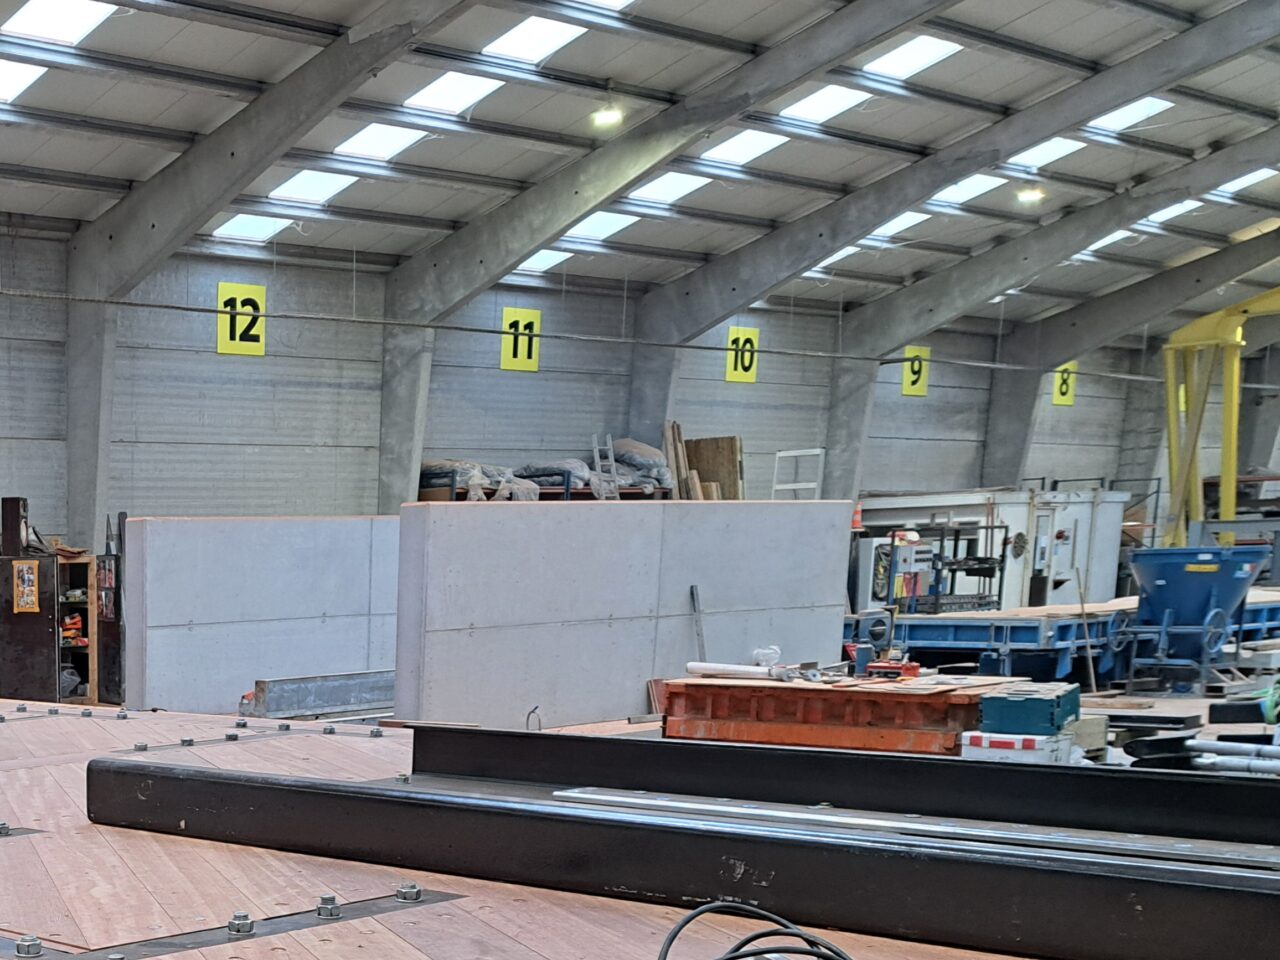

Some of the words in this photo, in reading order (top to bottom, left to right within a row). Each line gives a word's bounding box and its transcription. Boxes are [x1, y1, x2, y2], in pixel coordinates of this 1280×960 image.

[223, 297, 260, 342] 12
[508, 320, 534, 359] 11
[731, 338, 754, 372] 10
[910, 354, 923, 385] 9
[1059, 368, 1070, 396] 8
